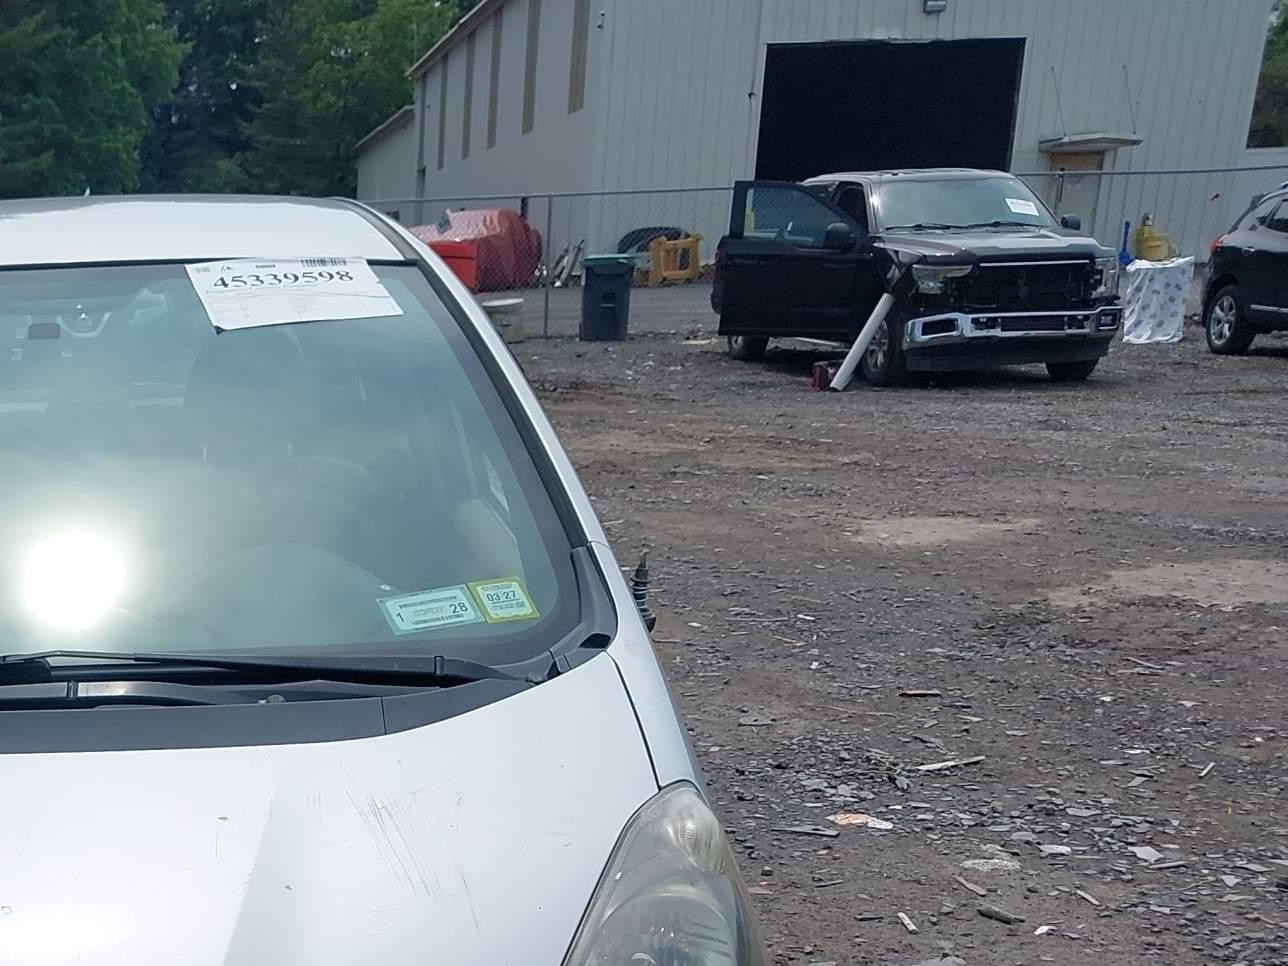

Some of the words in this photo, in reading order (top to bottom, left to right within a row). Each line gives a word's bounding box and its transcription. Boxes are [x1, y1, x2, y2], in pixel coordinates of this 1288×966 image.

[212, 269, 355, 289] 45339598
[486, 591, 501, 602] 03
[502, 590, 517, 600] 27
[448, 602, 469, 614] 28
